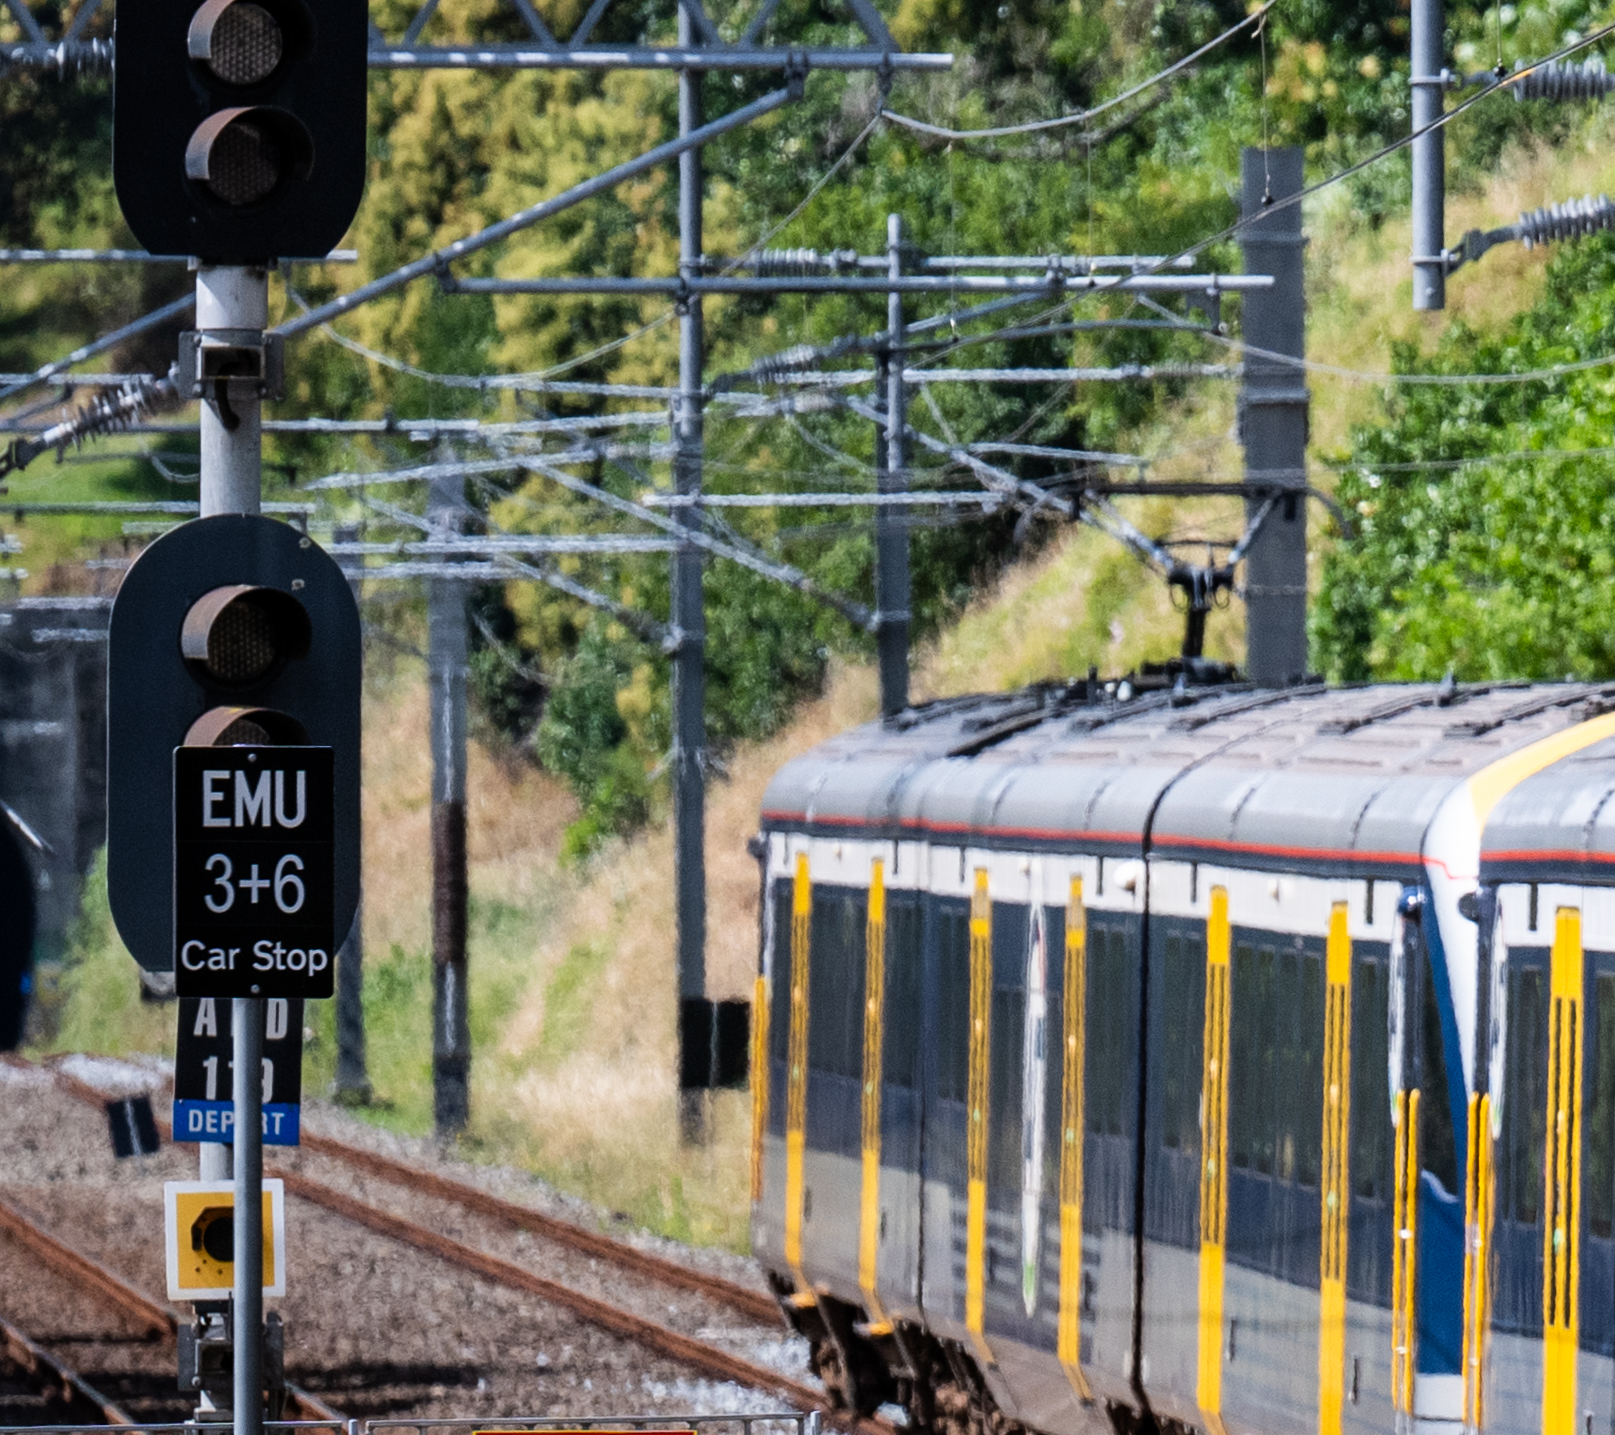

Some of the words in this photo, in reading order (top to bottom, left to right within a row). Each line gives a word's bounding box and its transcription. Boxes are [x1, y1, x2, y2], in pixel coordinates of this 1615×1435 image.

[202, 770, 306, 828] EMU
[204, 853, 306, 914] 3+6
[181, 939, 241, 971] Car
[252, 939, 328, 977] Stop
